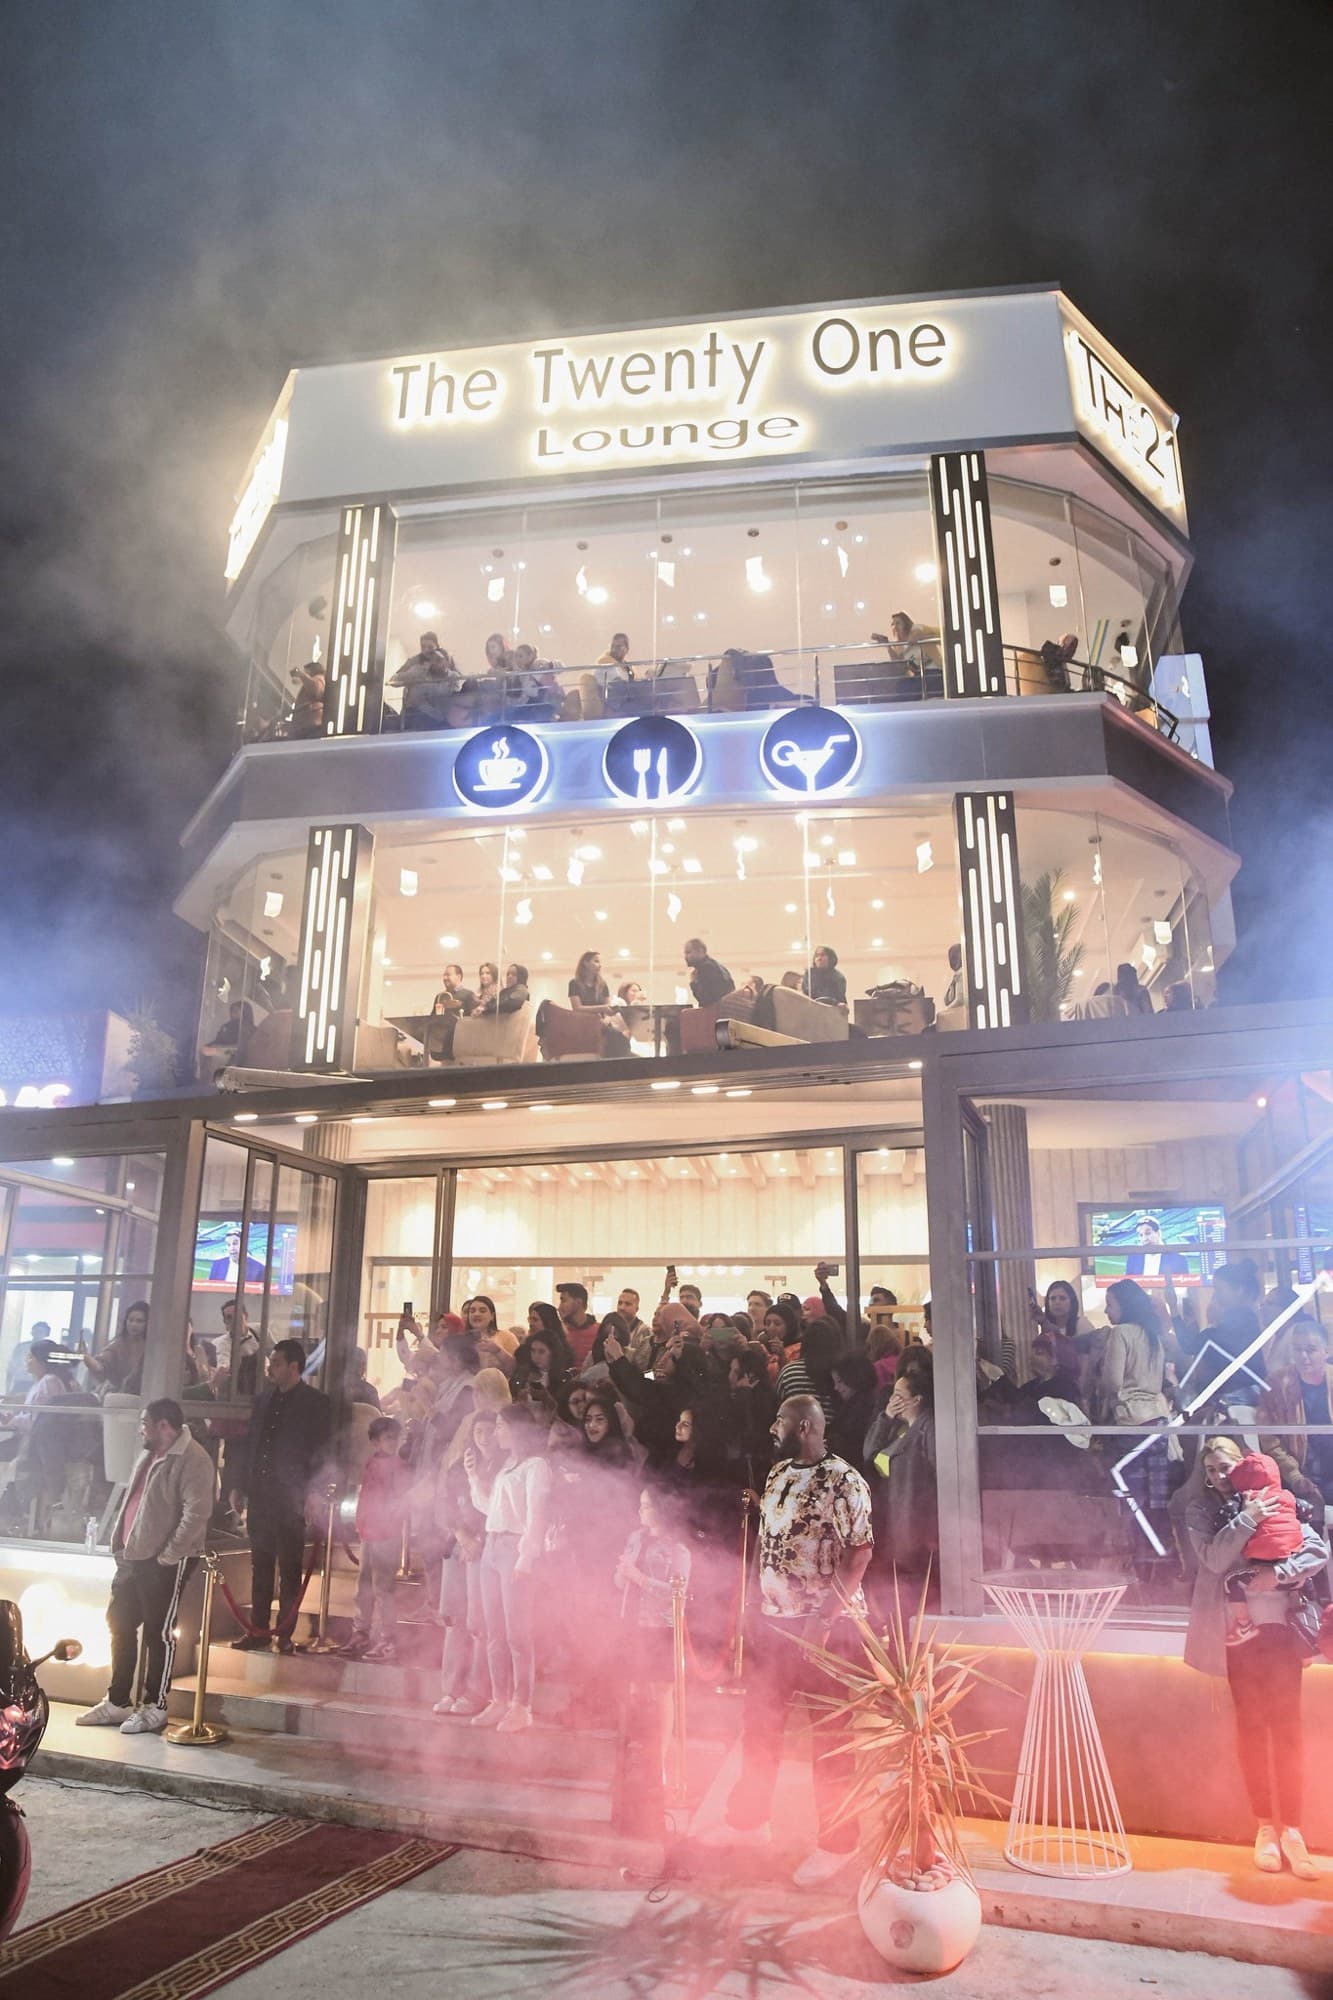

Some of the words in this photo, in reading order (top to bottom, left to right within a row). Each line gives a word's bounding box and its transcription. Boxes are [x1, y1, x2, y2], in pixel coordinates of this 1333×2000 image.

[393, 361, 497, 419] The
[534, 332, 764, 404] Twenty
[812, 318, 946, 375] One
[538, 416, 800, 456] Lounge
